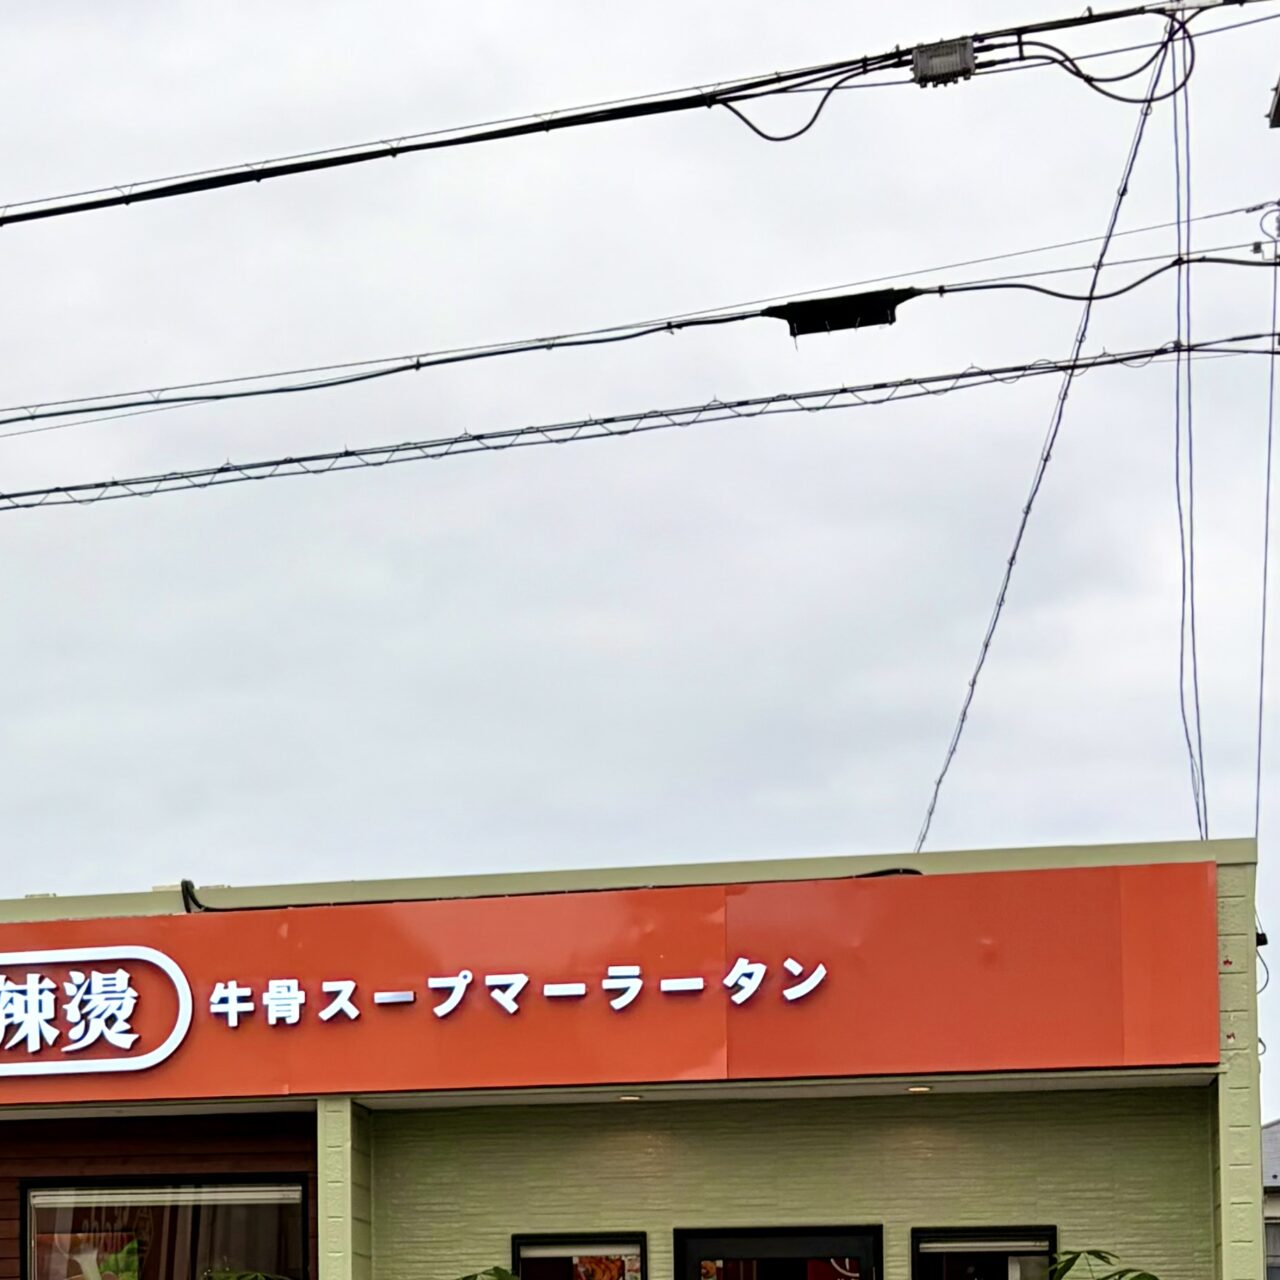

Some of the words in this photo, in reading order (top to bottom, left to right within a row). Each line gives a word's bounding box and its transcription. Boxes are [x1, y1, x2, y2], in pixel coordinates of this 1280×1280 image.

[208, 958, 828, 1028] 牛骨スープマーラータン
